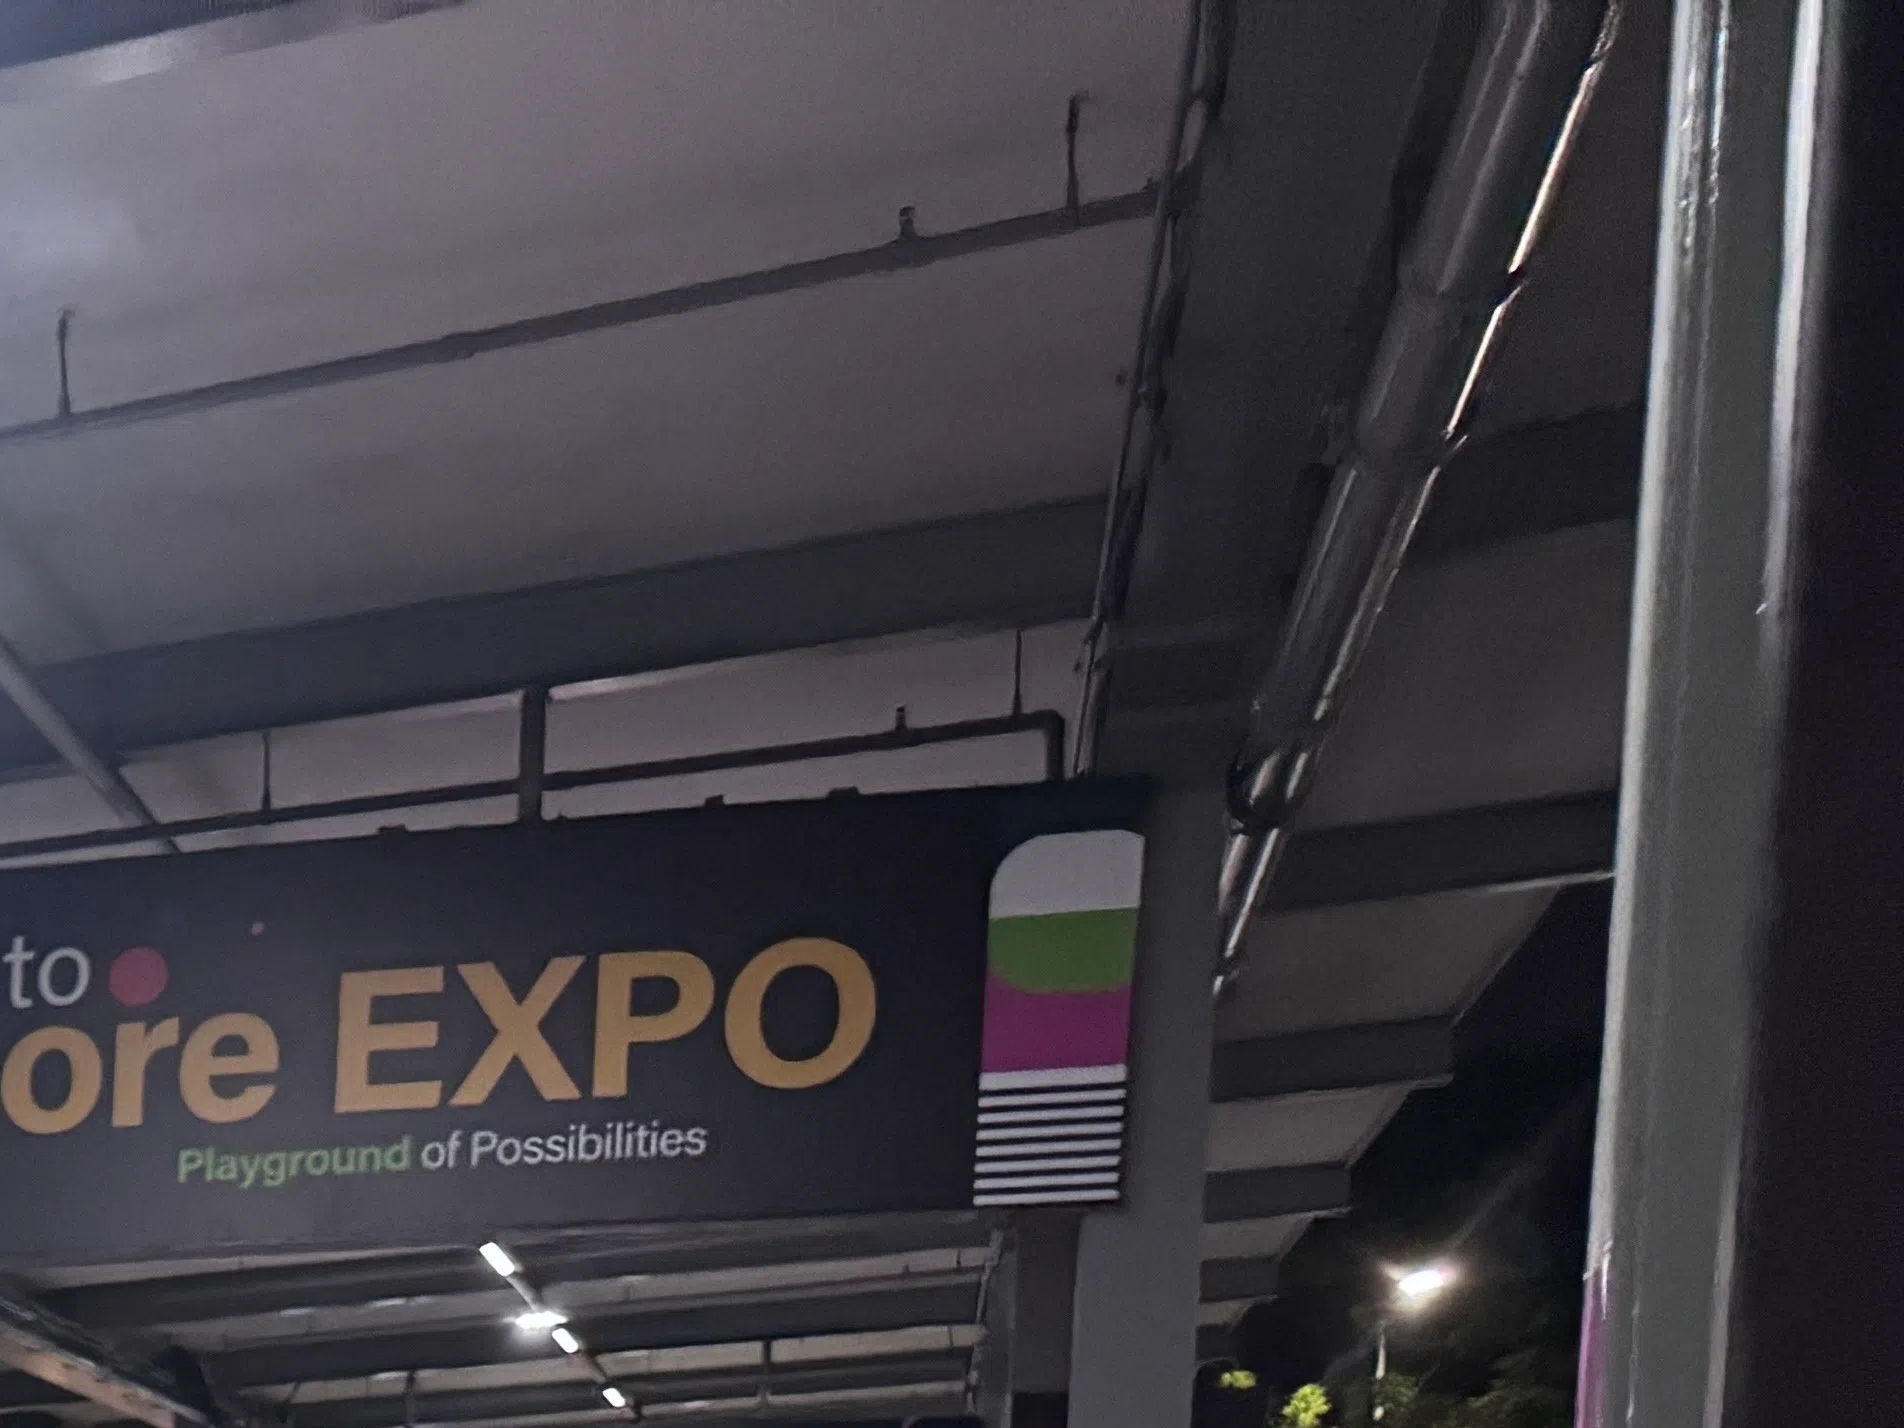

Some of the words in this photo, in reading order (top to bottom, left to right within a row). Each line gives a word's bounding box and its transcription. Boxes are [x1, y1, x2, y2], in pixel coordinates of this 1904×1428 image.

[2, 936, 91, 1008] to
[333, 936, 877, 1115] EXPO
[177, 1135, 413, 1189] Playground
[421, 1131, 462, 1170] of
[470, 1119, 708, 1168] Possibilities
